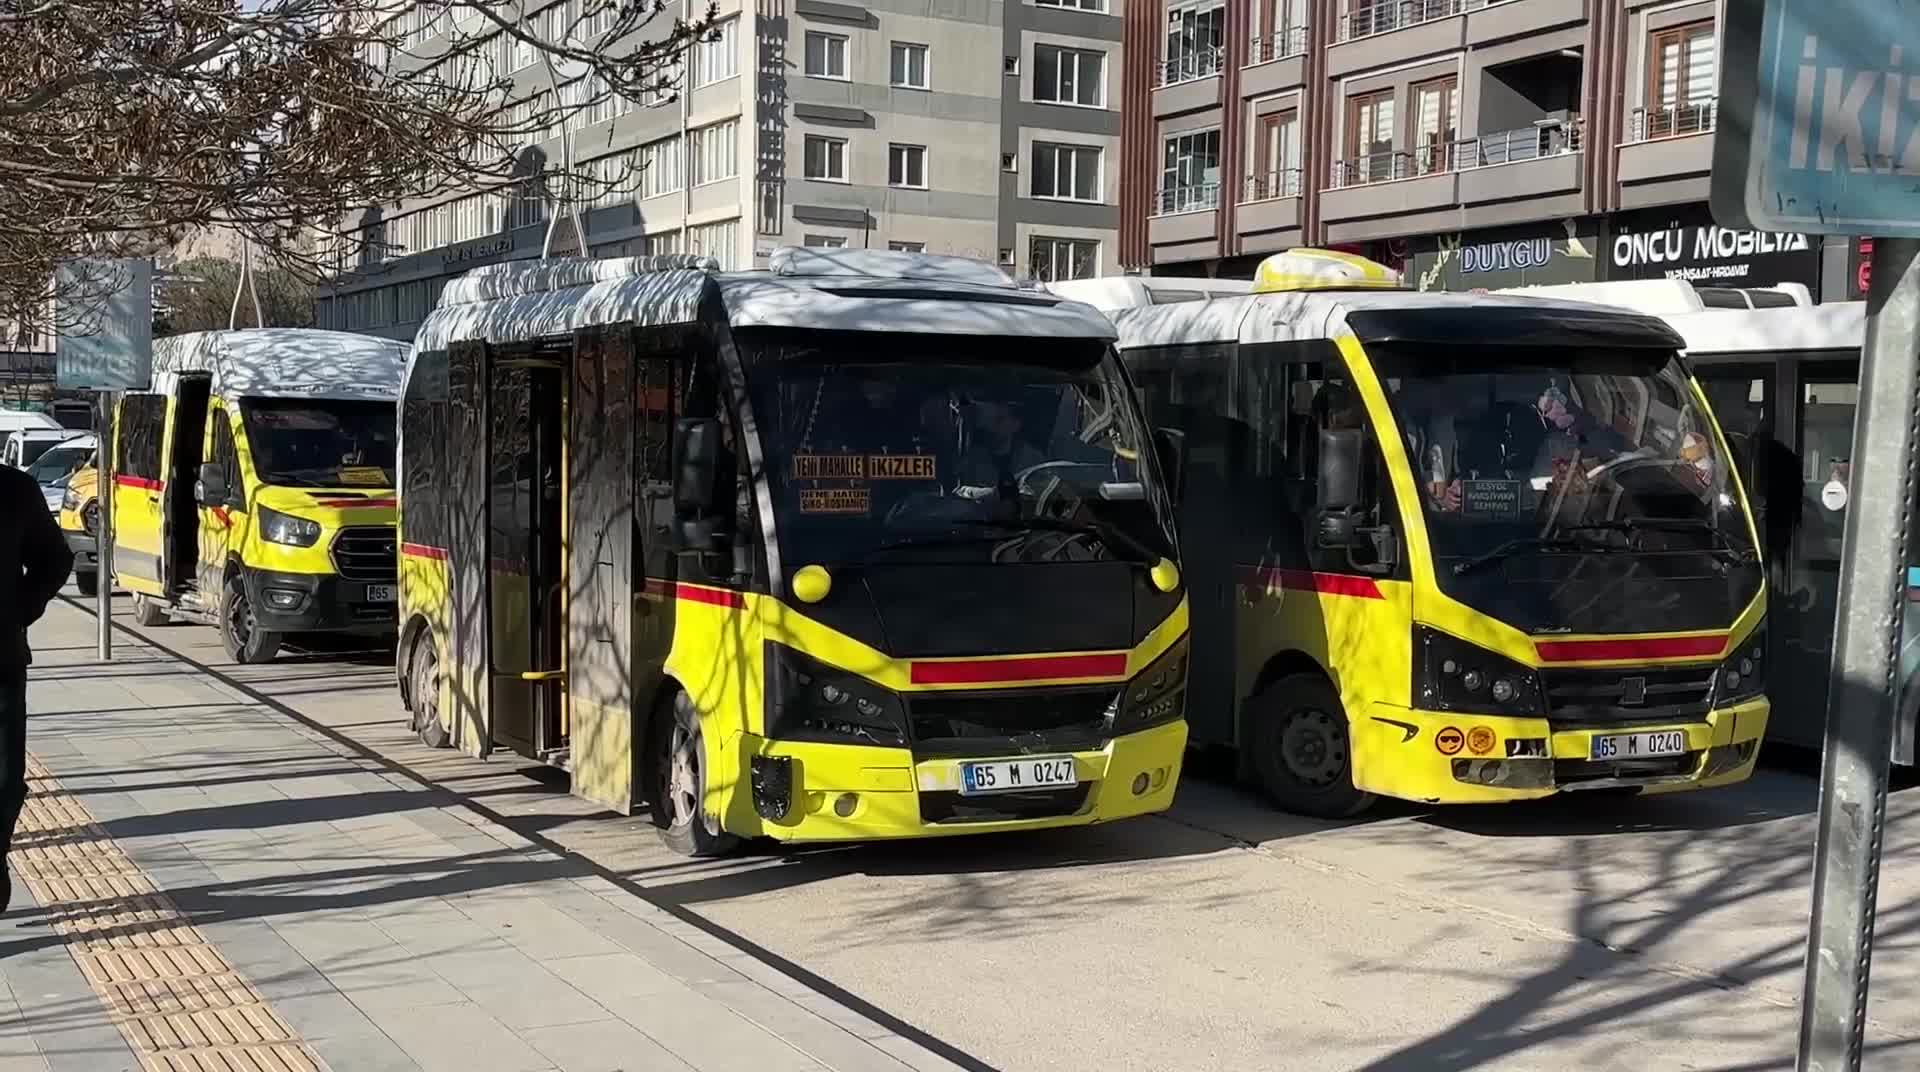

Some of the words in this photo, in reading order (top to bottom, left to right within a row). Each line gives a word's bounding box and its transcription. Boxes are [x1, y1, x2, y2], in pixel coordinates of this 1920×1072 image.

[1460, 237, 1551, 273] DUYGU
[1613, 220, 1683, 267] ÖNCÜ
[871, 457, 934, 476] İKİZLER
[375, 587, 389, 600] 65
[1600, 738, 1617, 757] 65
[1628, 736, 1637, 753] M
[1648, 732, 1682, 752] 0240
[975, 766, 996, 787] 65
[1009, 763, 1021, 785] M
[1033, 761, 1072, 783] 0247
